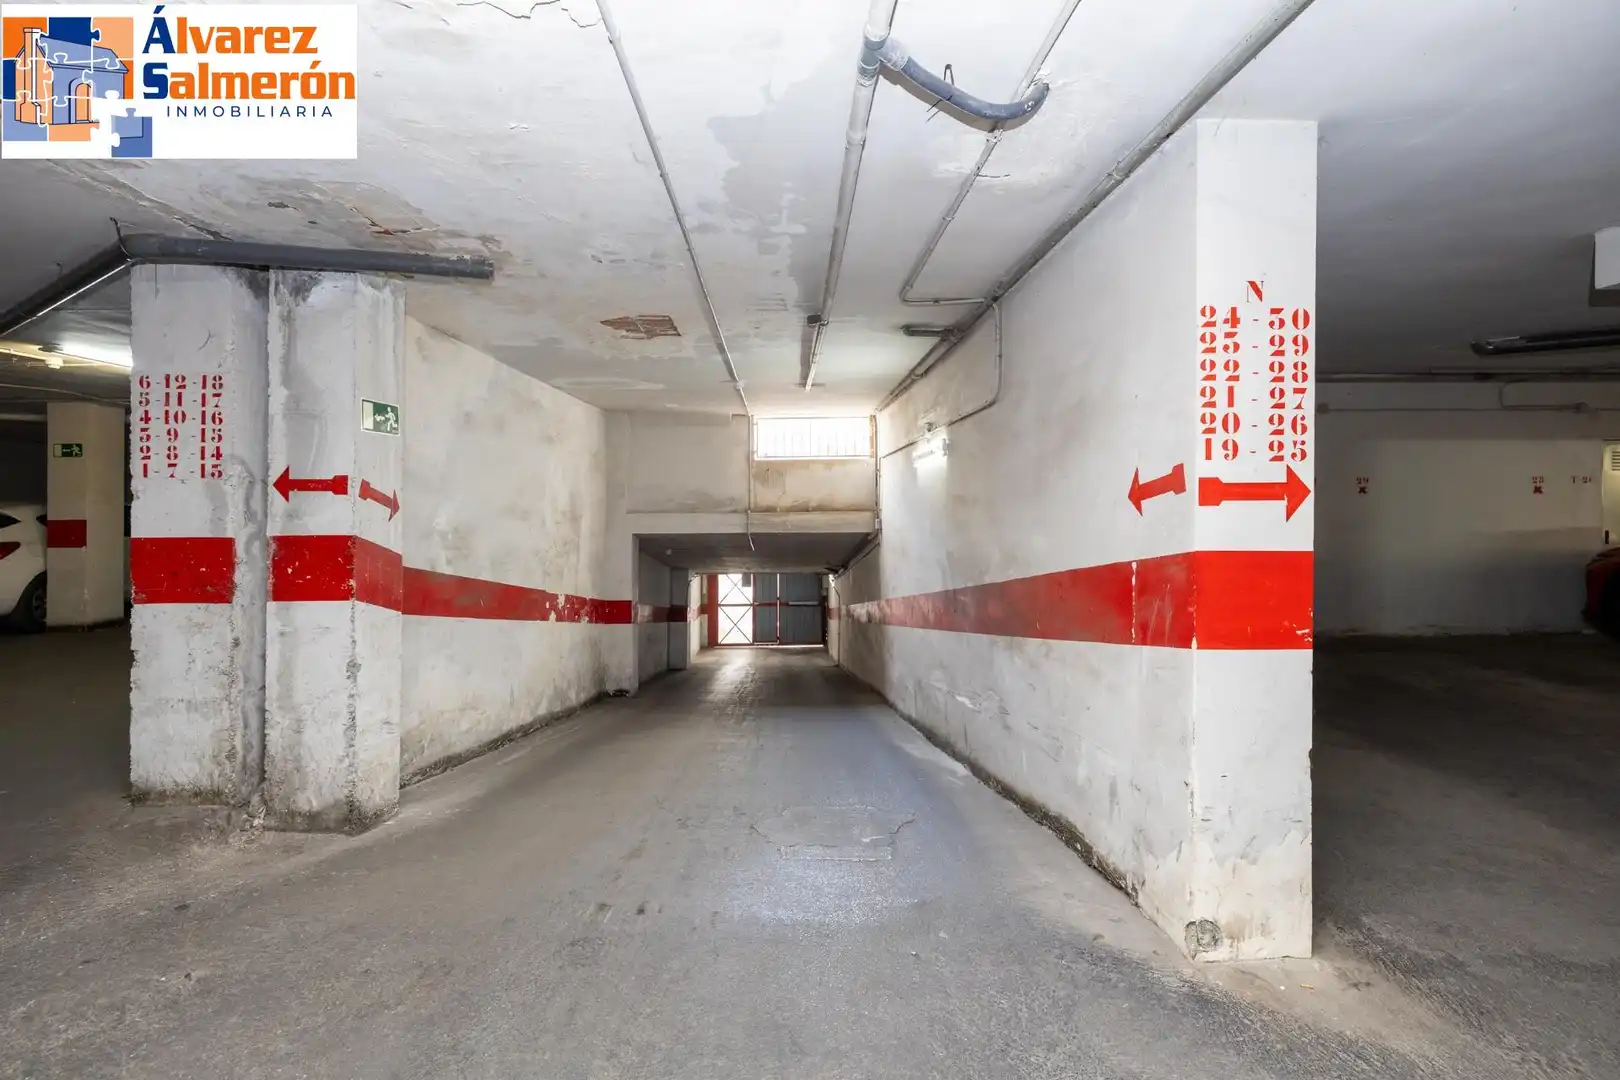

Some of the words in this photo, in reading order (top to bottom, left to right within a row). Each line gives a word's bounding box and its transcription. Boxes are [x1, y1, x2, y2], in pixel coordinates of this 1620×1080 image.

[1246, 280, 1264, 302] N
[1200, 304, 1240, 329] 24
[1268, 307, 1310, 330] 30
[1200, 331, 1240, 354] 23
[1268, 335, 1309, 357] 29
[1200, 359, 1240, 382] 22
[1268, 361, 1309, 383] 28
[1200, 385, 1235, 408] 21
[1269, 387, 1307, 410] 27
[1200, 413, 1240, 434] 20
[1268, 414, 1308, 436] 26
[1205, 438, 1239, 460] 19
[1268, 440, 1307, 462] 25
